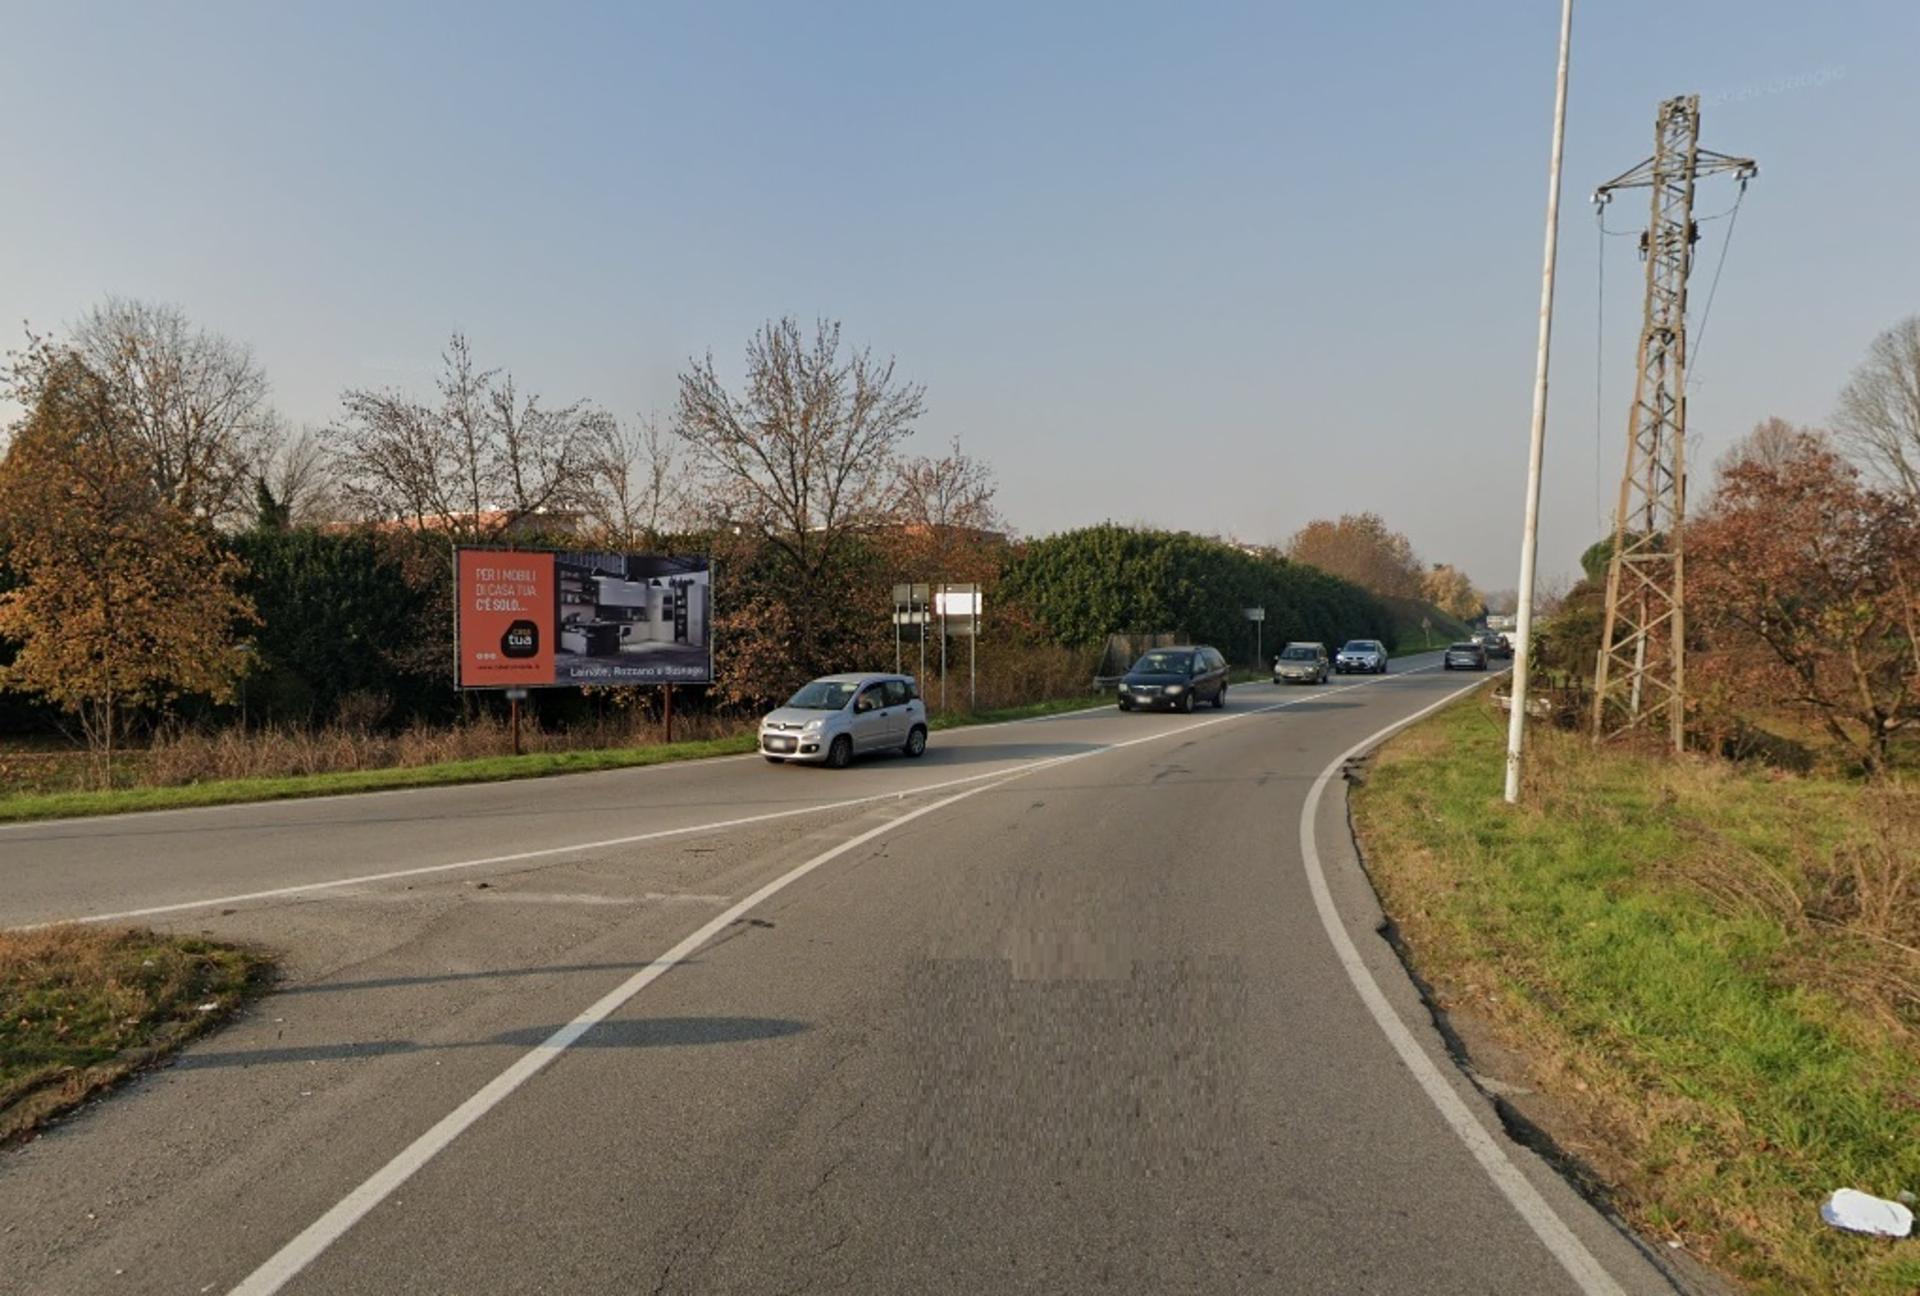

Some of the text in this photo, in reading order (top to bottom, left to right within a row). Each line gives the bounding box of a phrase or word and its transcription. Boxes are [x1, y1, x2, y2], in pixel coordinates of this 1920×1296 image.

[476, 568, 495, 581] PER
[502, 569, 536, 582] MOBILI
[476, 583, 486, 596] DI
[488, 583, 515, 596] CASA
[508, 634, 532, 645] tua
